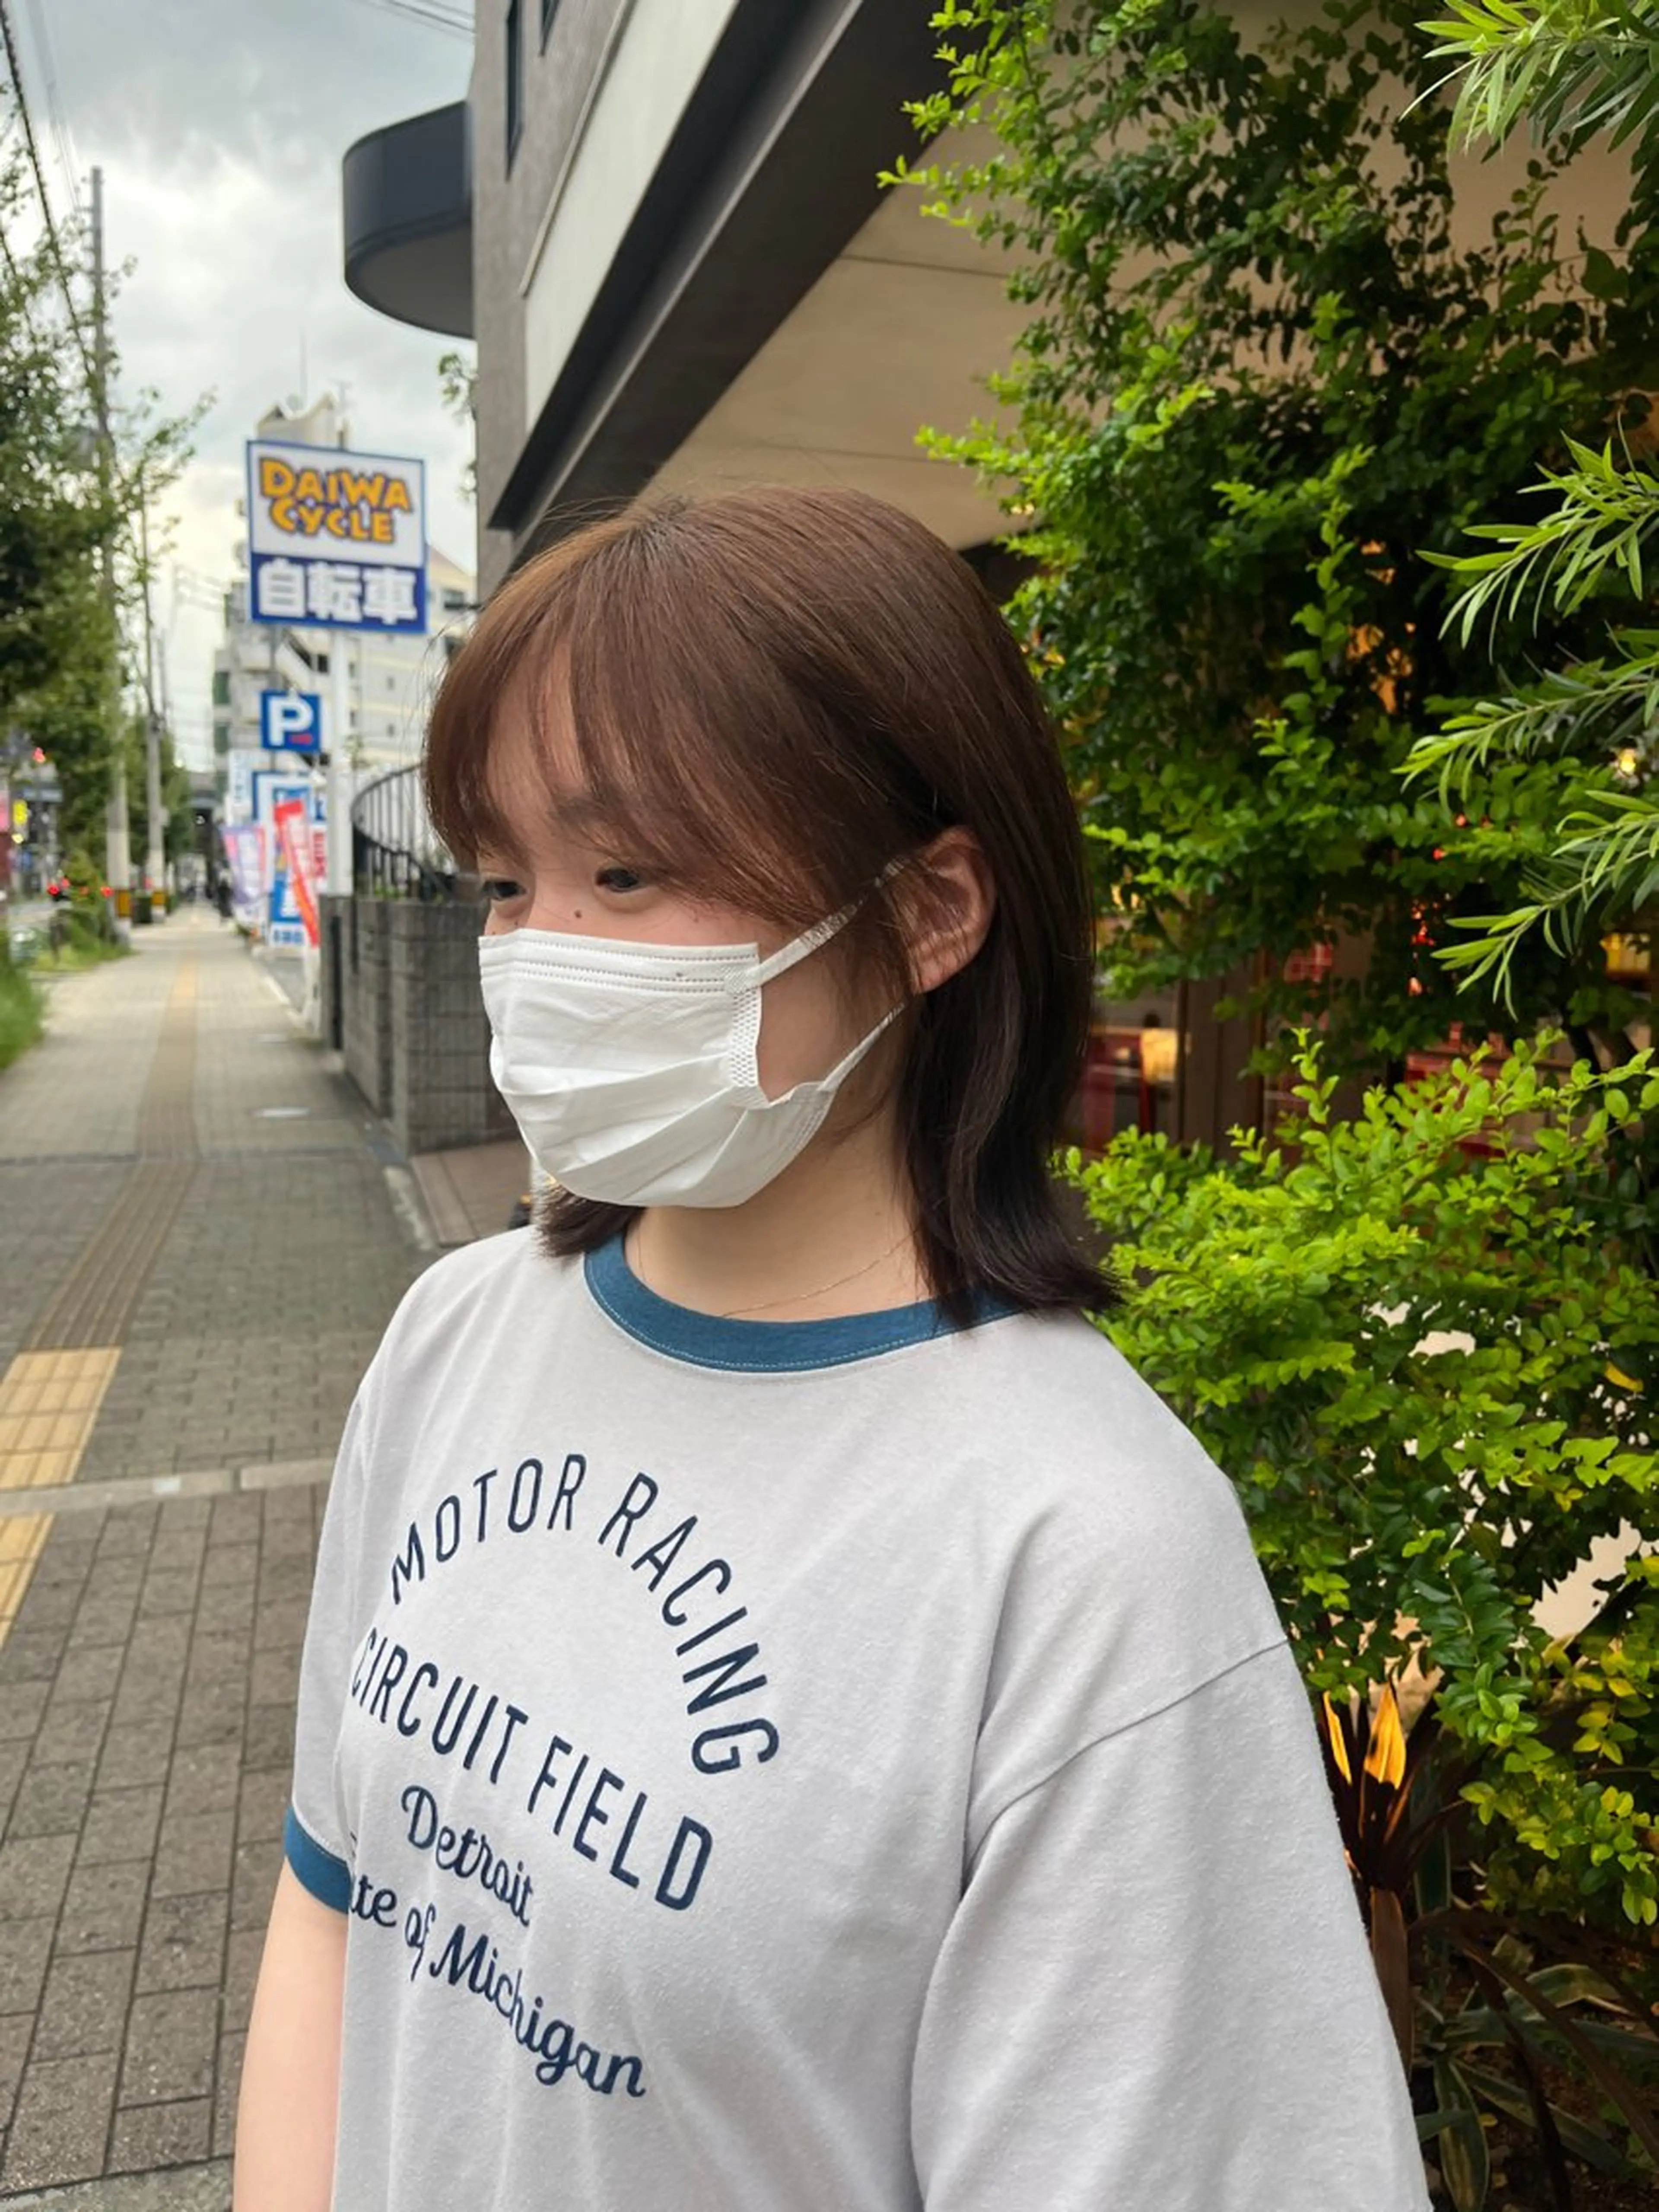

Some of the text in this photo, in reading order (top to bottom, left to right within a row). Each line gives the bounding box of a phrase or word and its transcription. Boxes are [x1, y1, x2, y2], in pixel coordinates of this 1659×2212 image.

[259, 457, 413, 514] DAIWA
[269, 496, 394, 543] CYCLE
[258, 557, 418, 625] 自転車
[267, 695, 314, 747] P
[391, 1454, 779, 1774] MOTOR RACING
[352, 1627, 712, 1911] CIRCUIT FIELD
[404, 1902, 436, 1982] of
[429, 1923, 647, 2098] Michigan
